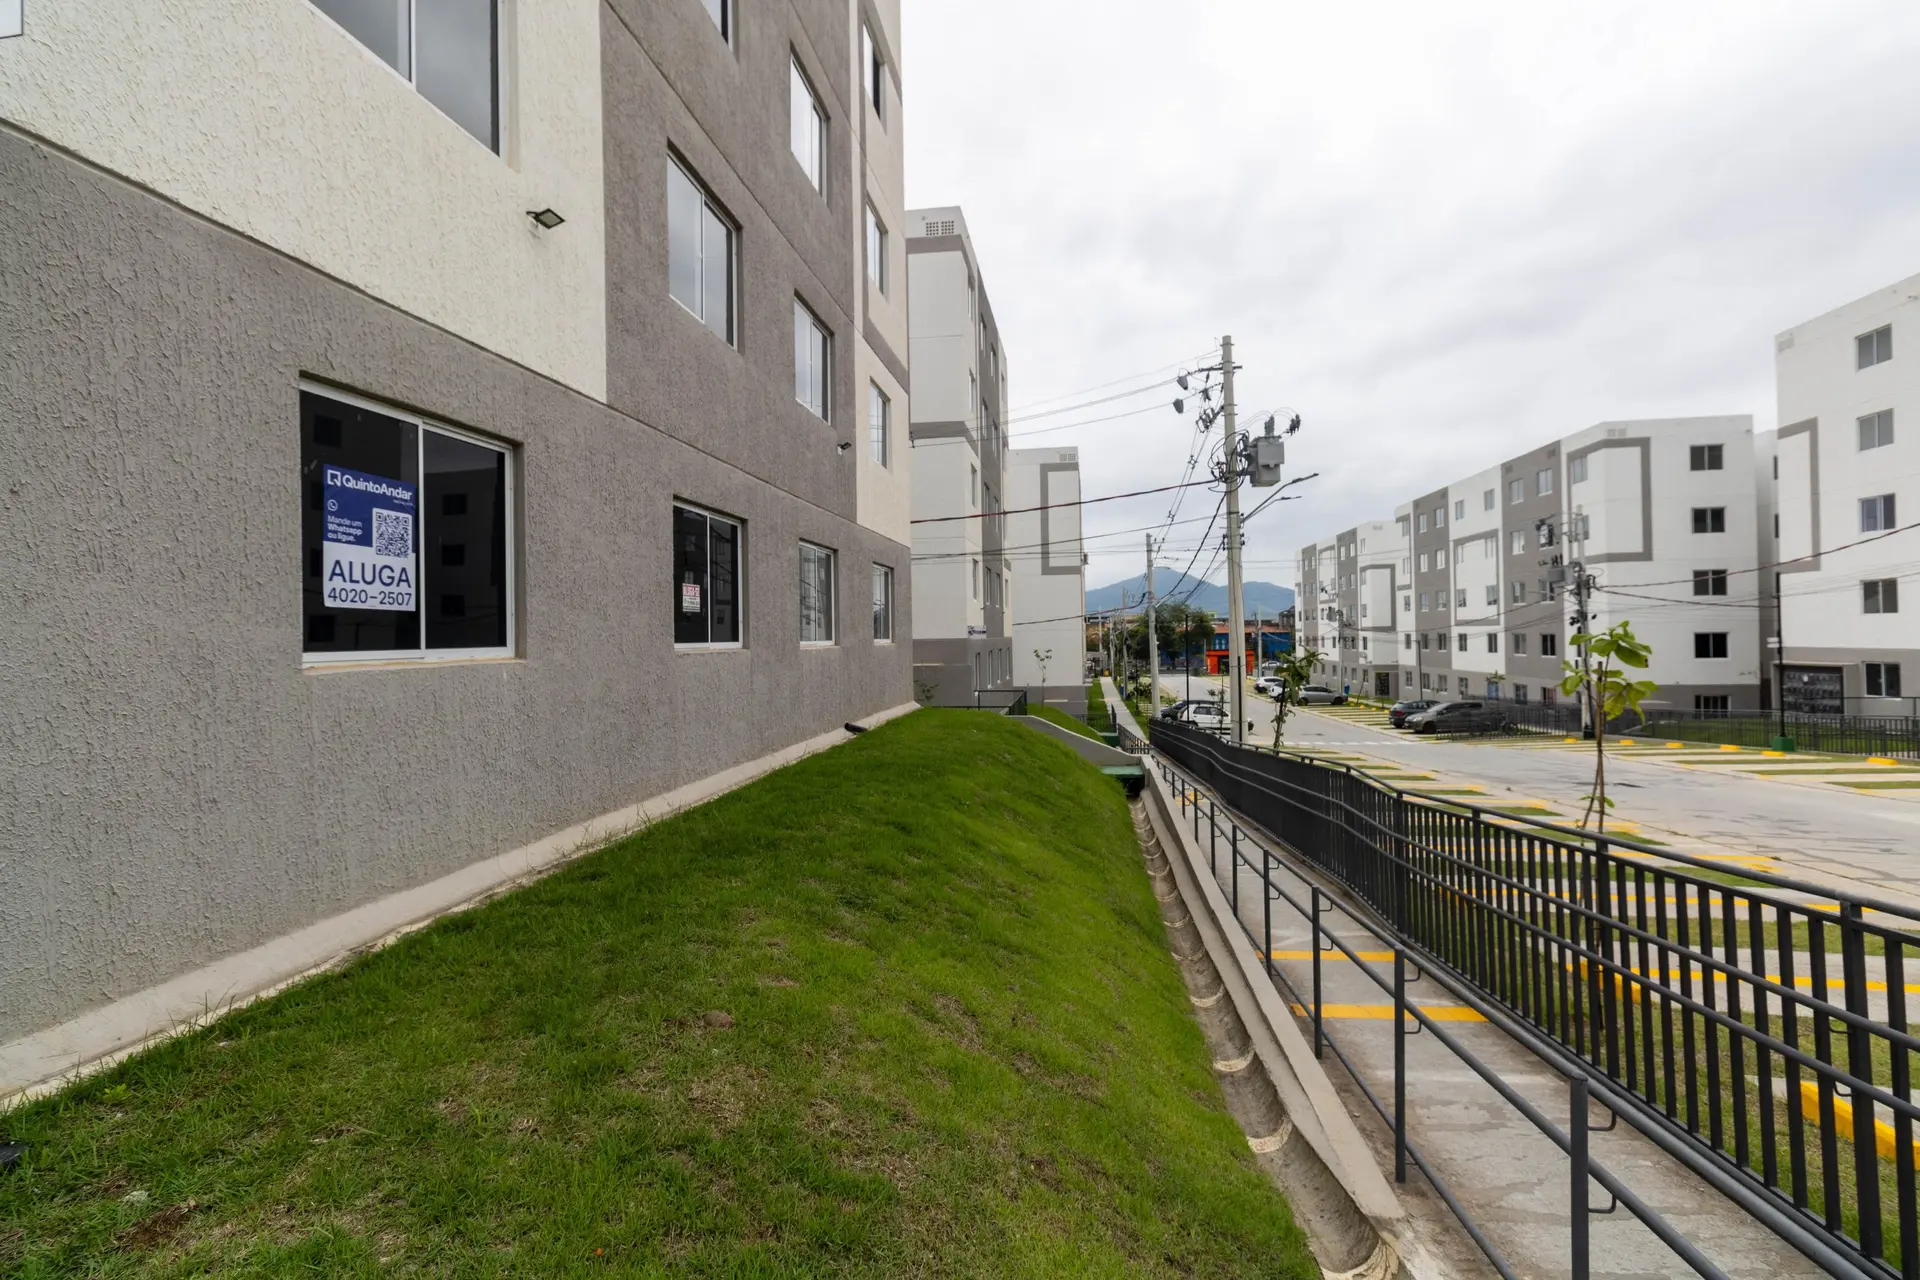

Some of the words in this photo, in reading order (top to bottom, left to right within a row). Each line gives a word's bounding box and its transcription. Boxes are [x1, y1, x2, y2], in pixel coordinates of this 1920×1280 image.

[342, 475, 412, 500] QuintoAndar
[327, 515, 351, 526] Mande
[351, 520, 362, 528] um
[327, 523, 363, 536] Whatsapp
[328, 559, 412, 588] ALUGA
[327, 587, 412, 607] 4020-2507
